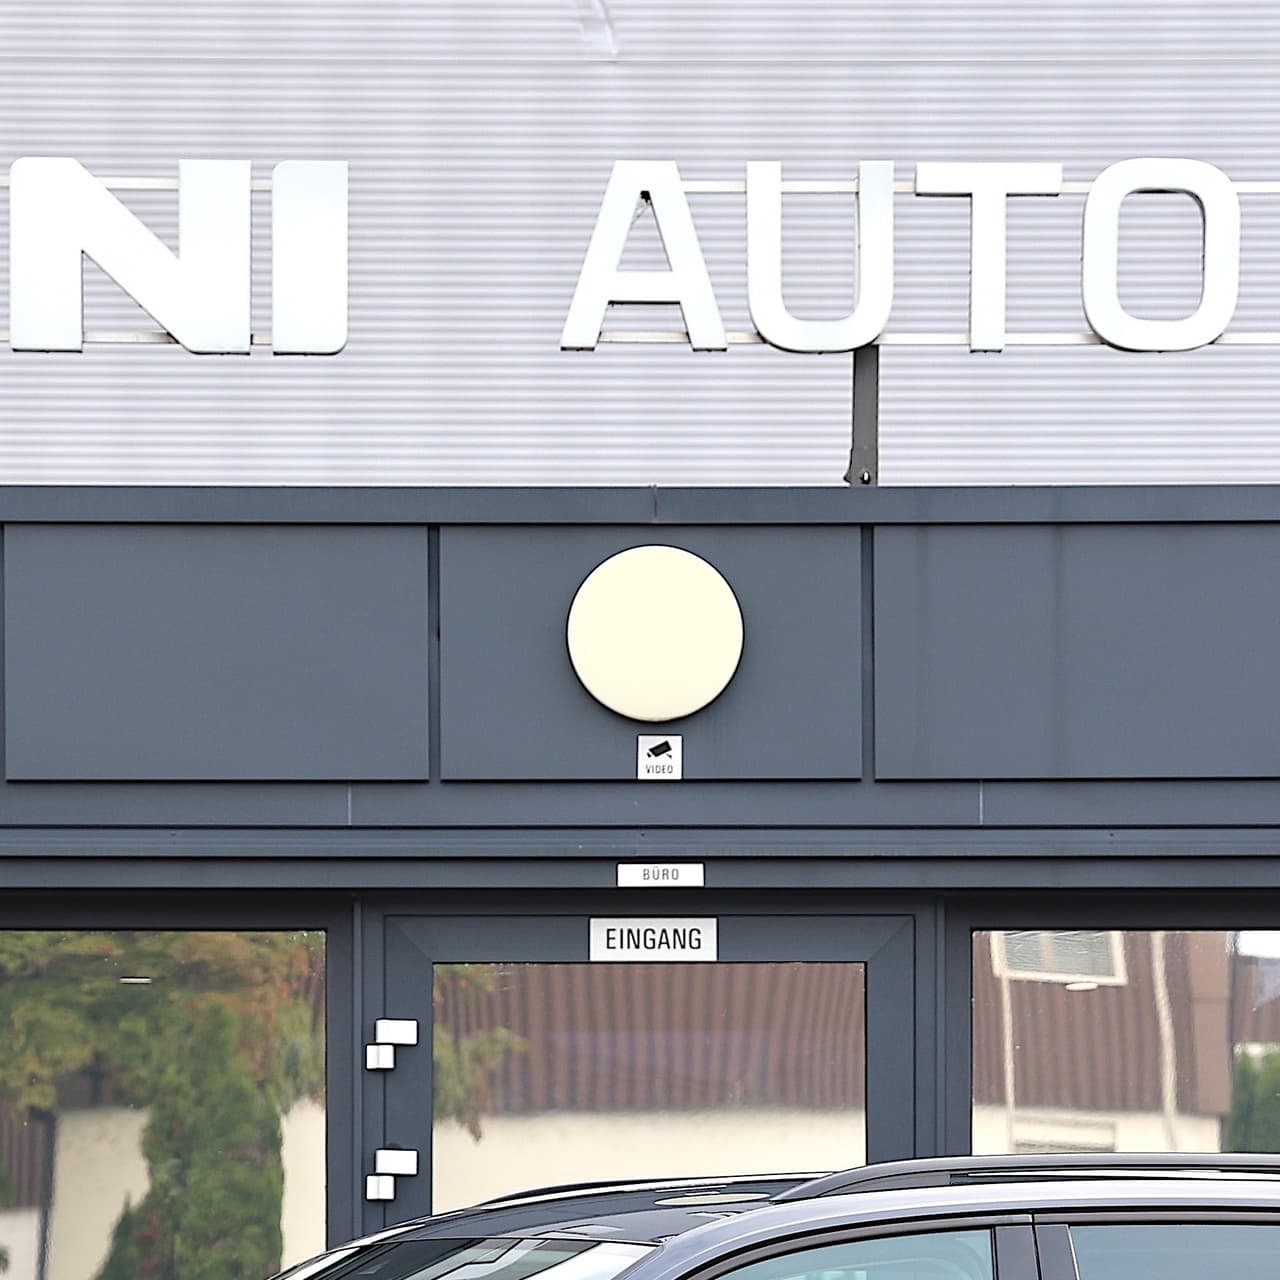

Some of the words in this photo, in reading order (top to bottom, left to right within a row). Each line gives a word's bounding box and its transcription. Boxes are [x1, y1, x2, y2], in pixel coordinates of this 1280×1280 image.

[560, 156, 1239, 353] AUTO
[645, 764, 674, 774] VIDEO
[642, 865, 680, 881] BÜRO
[606, 927, 702, 950] EINGANG
